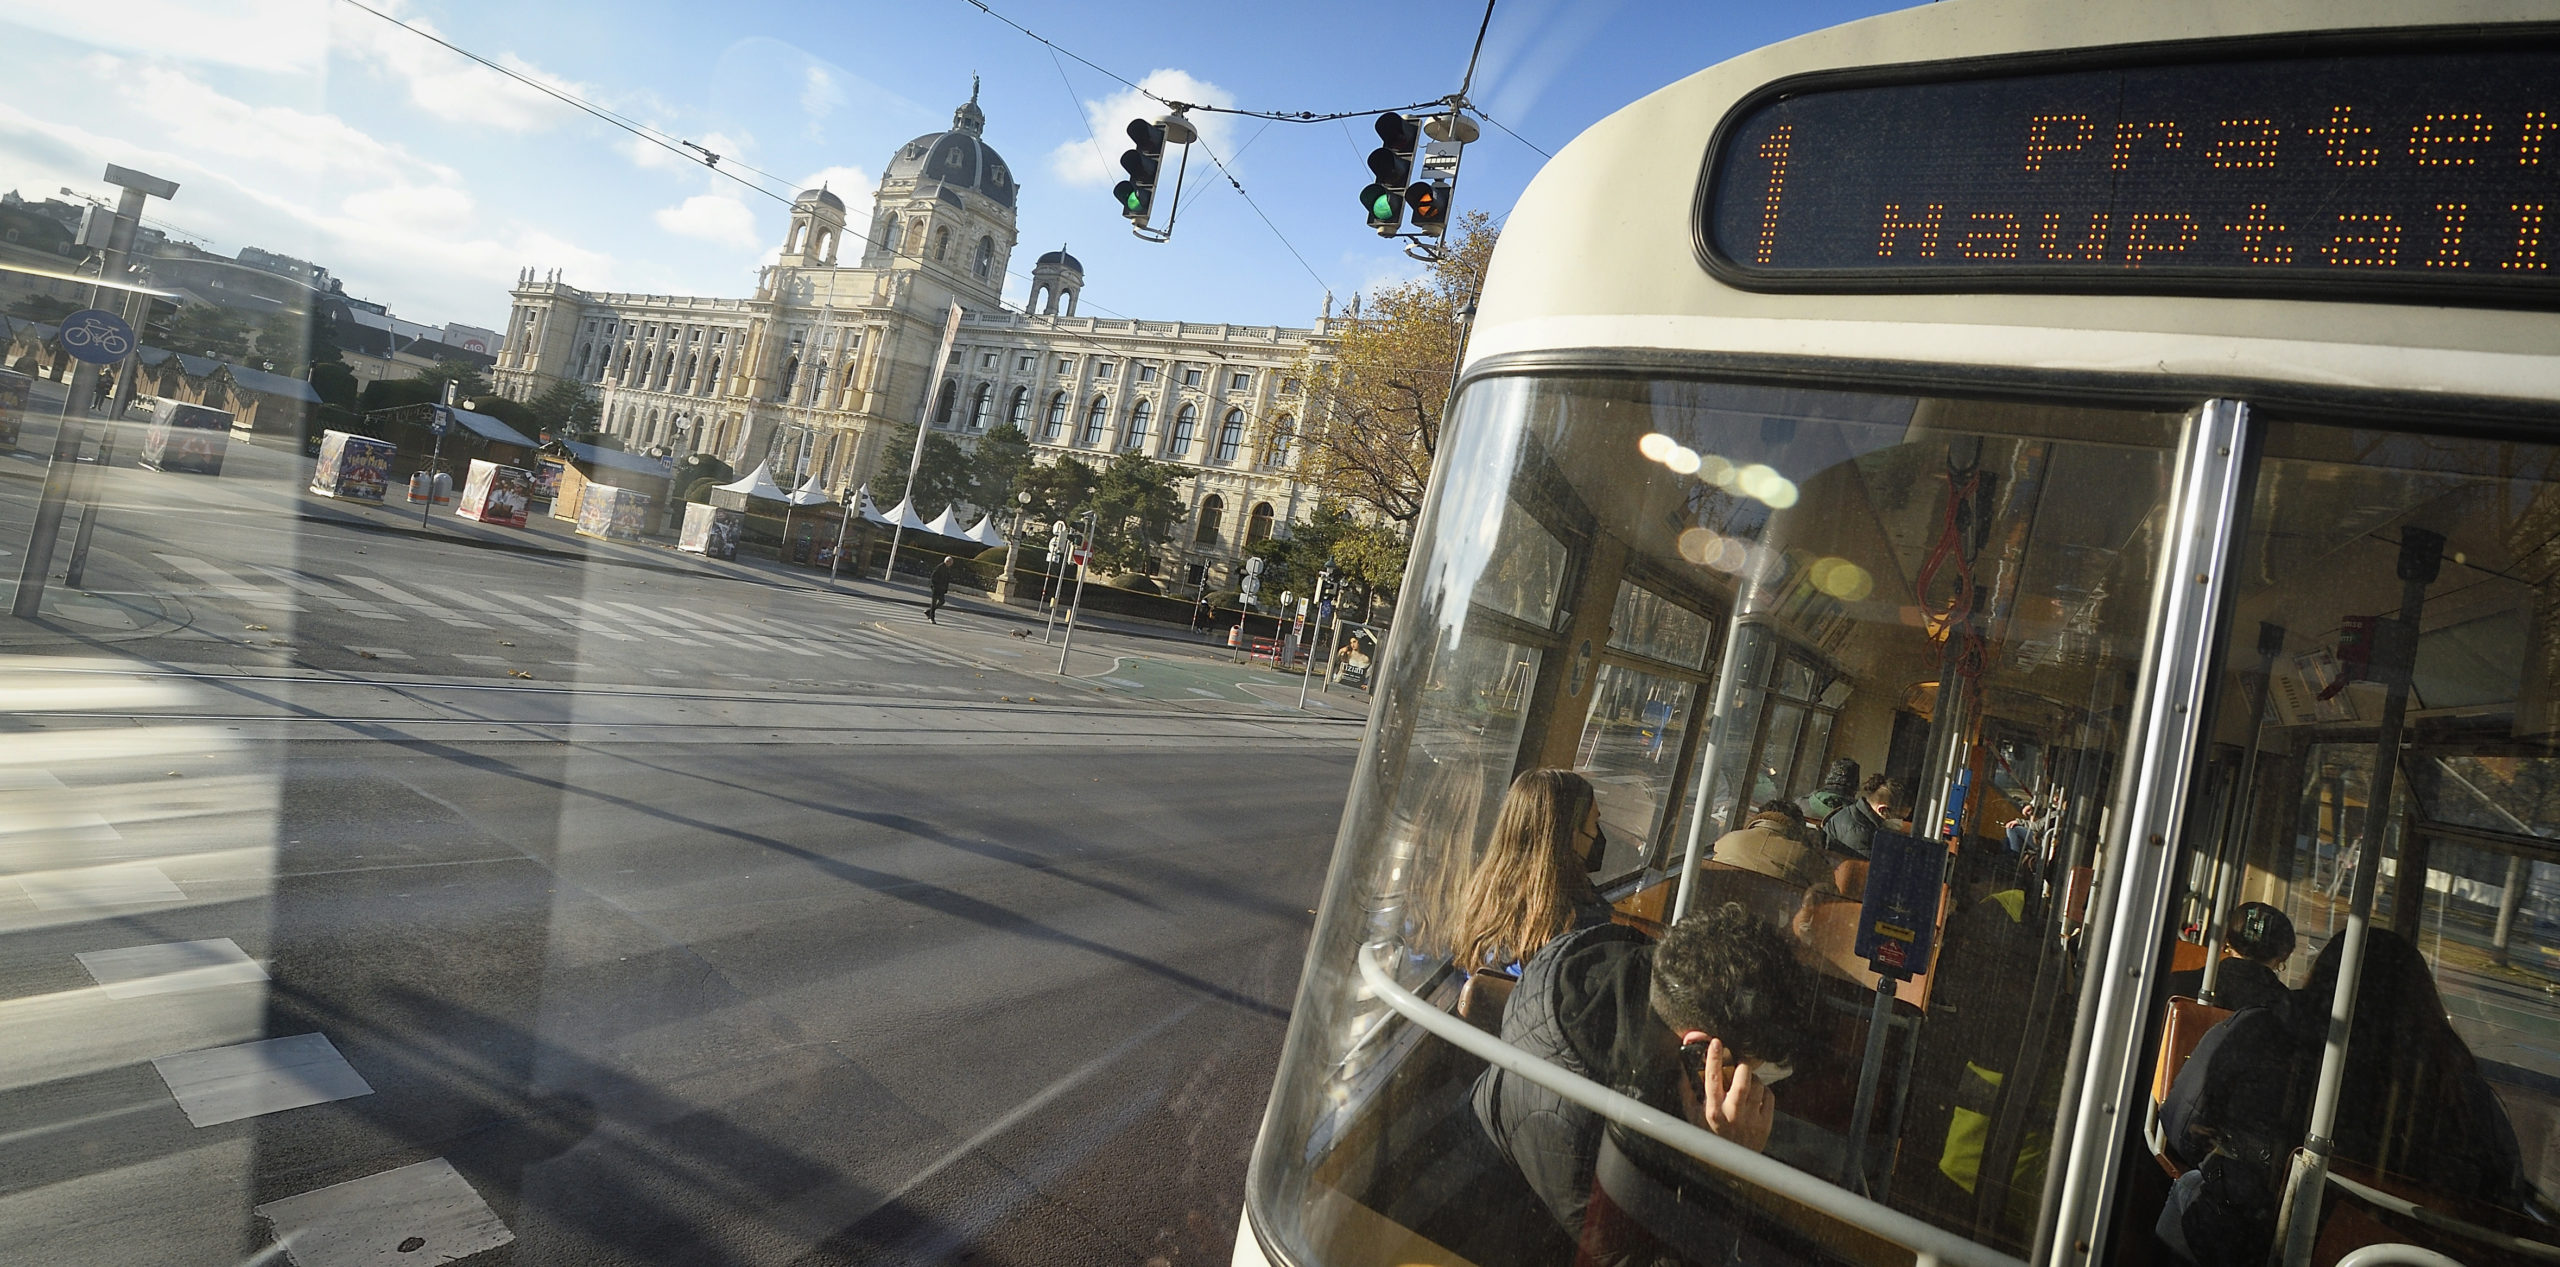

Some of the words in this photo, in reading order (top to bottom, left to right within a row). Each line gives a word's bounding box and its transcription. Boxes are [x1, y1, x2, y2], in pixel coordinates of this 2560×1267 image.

[2024, 105, 2560, 171] Prater
[1756, 124, 1792, 264] 1
[1877, 202, 2548, 270] Hauptall
